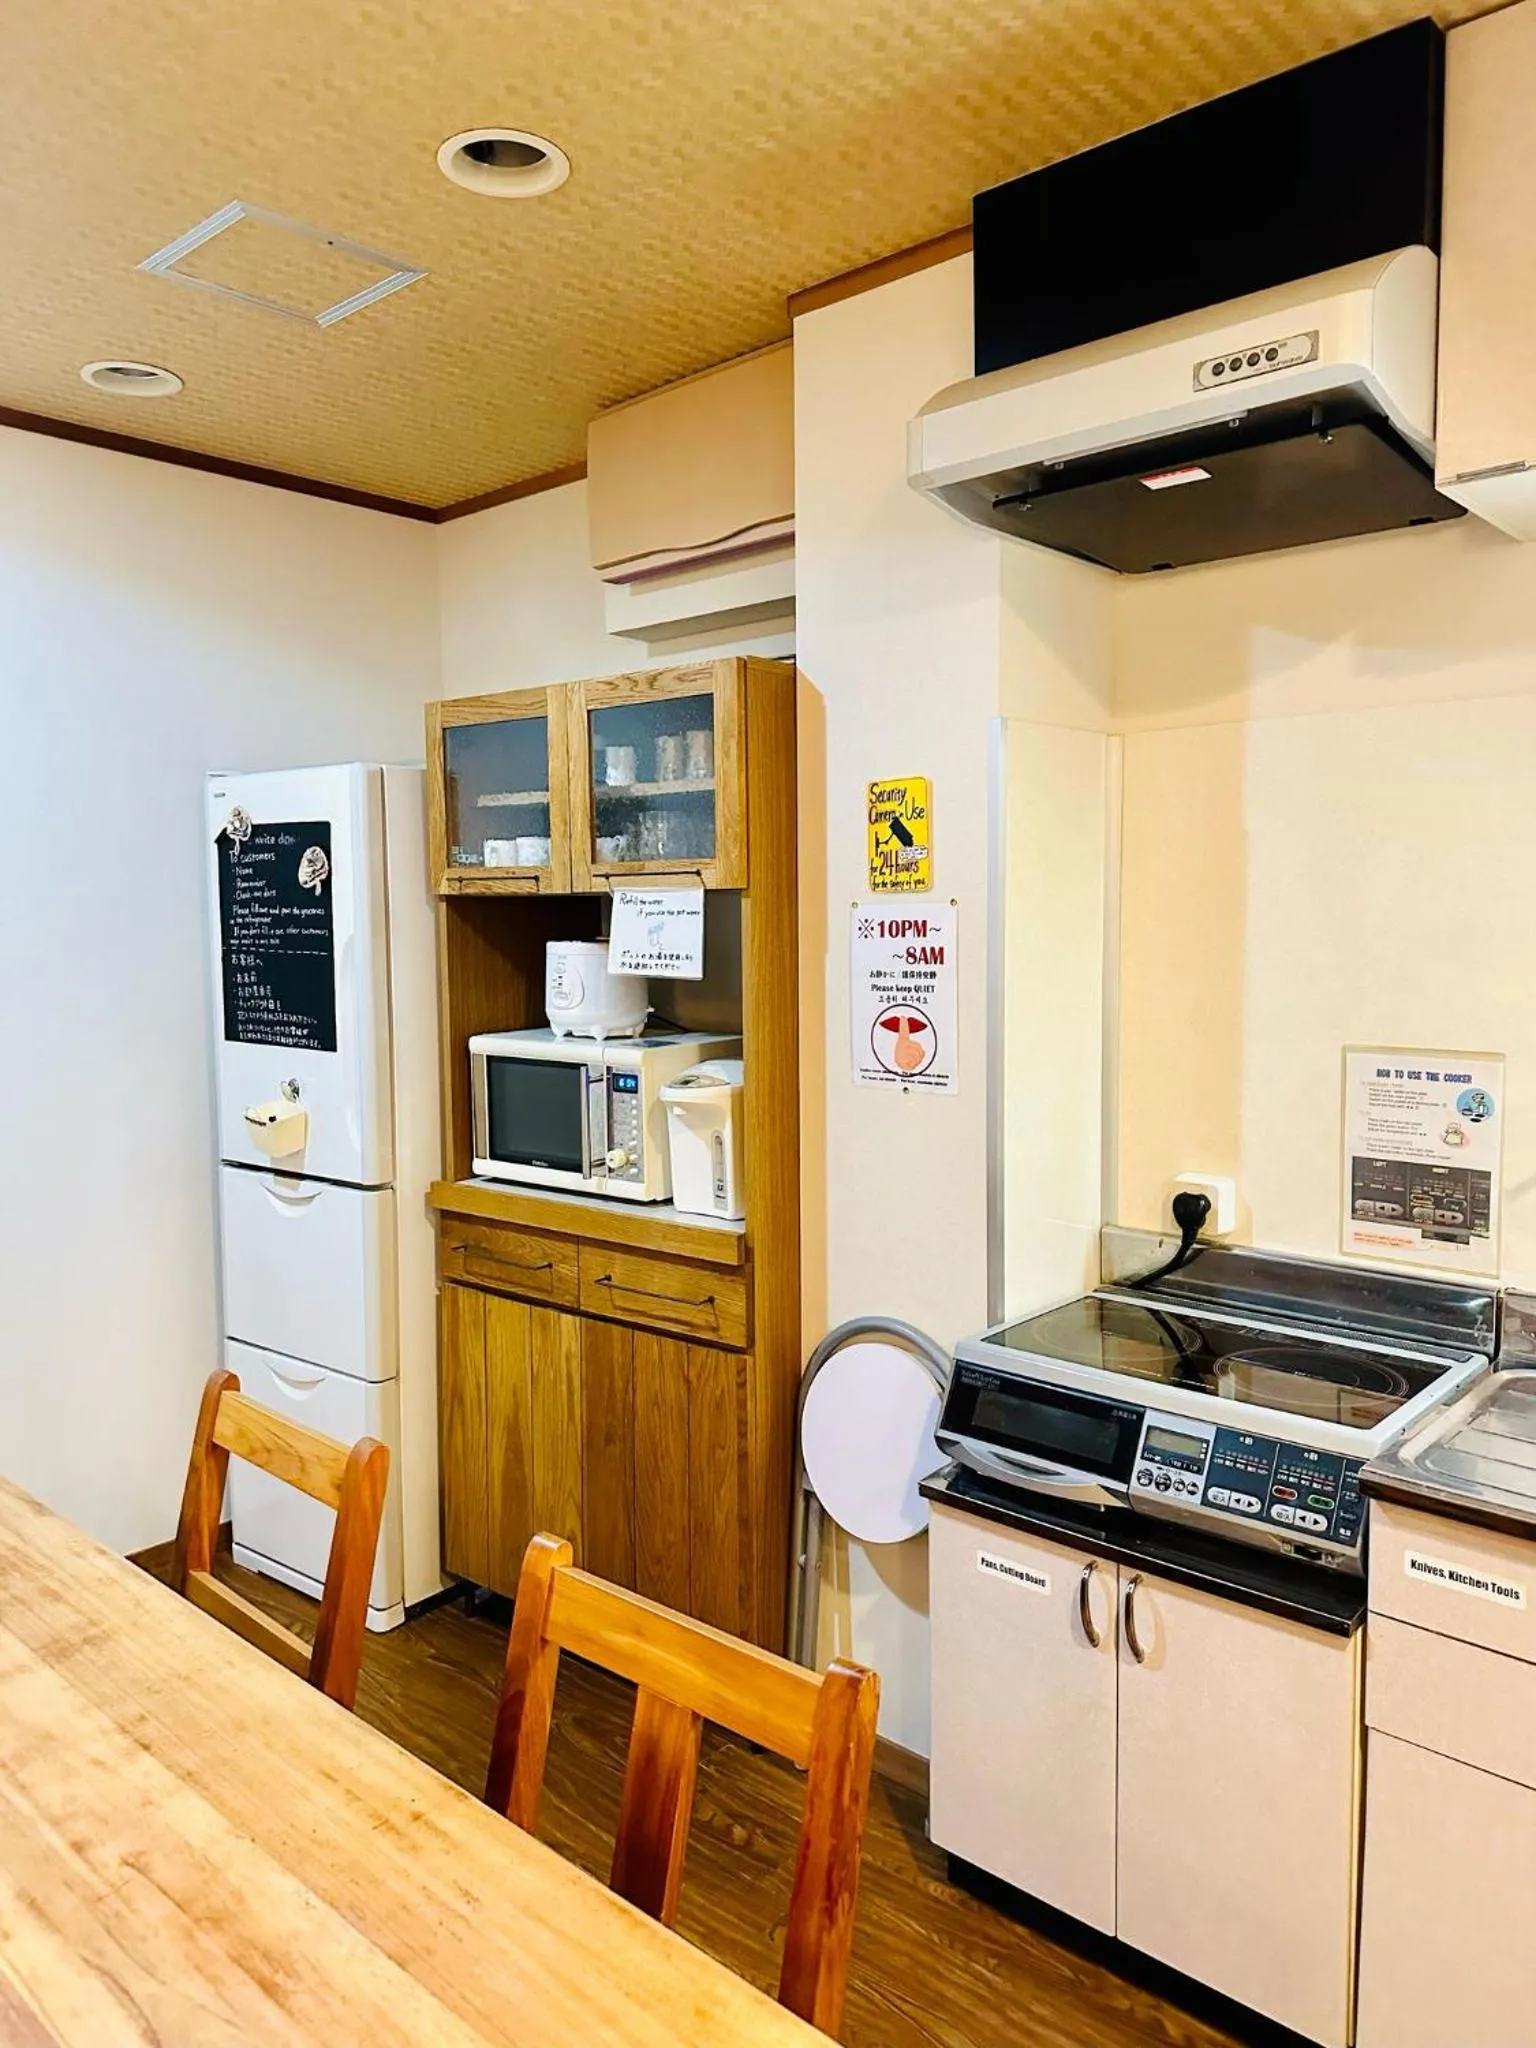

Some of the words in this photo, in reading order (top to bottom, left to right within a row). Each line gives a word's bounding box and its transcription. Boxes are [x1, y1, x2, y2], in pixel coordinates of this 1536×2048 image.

[869, 783, 907, 806] Security
[904, 797, 925, 821] Use
[879, 849, 894, 876] 24
[871, 983, 895, 992] Please
[895, 984, 913, 994] keep
[913, 984, 936, 994] QUIET
[1394, 1069, 1405, 1080] TO
[1407, 1070, 1423, 1081] USE
[1410, 1558, 1447, 1580] Knives,
[1448, 1569, 1489, 1591] Kitchen
[1490, 1582, 1521, 1600] Tools
